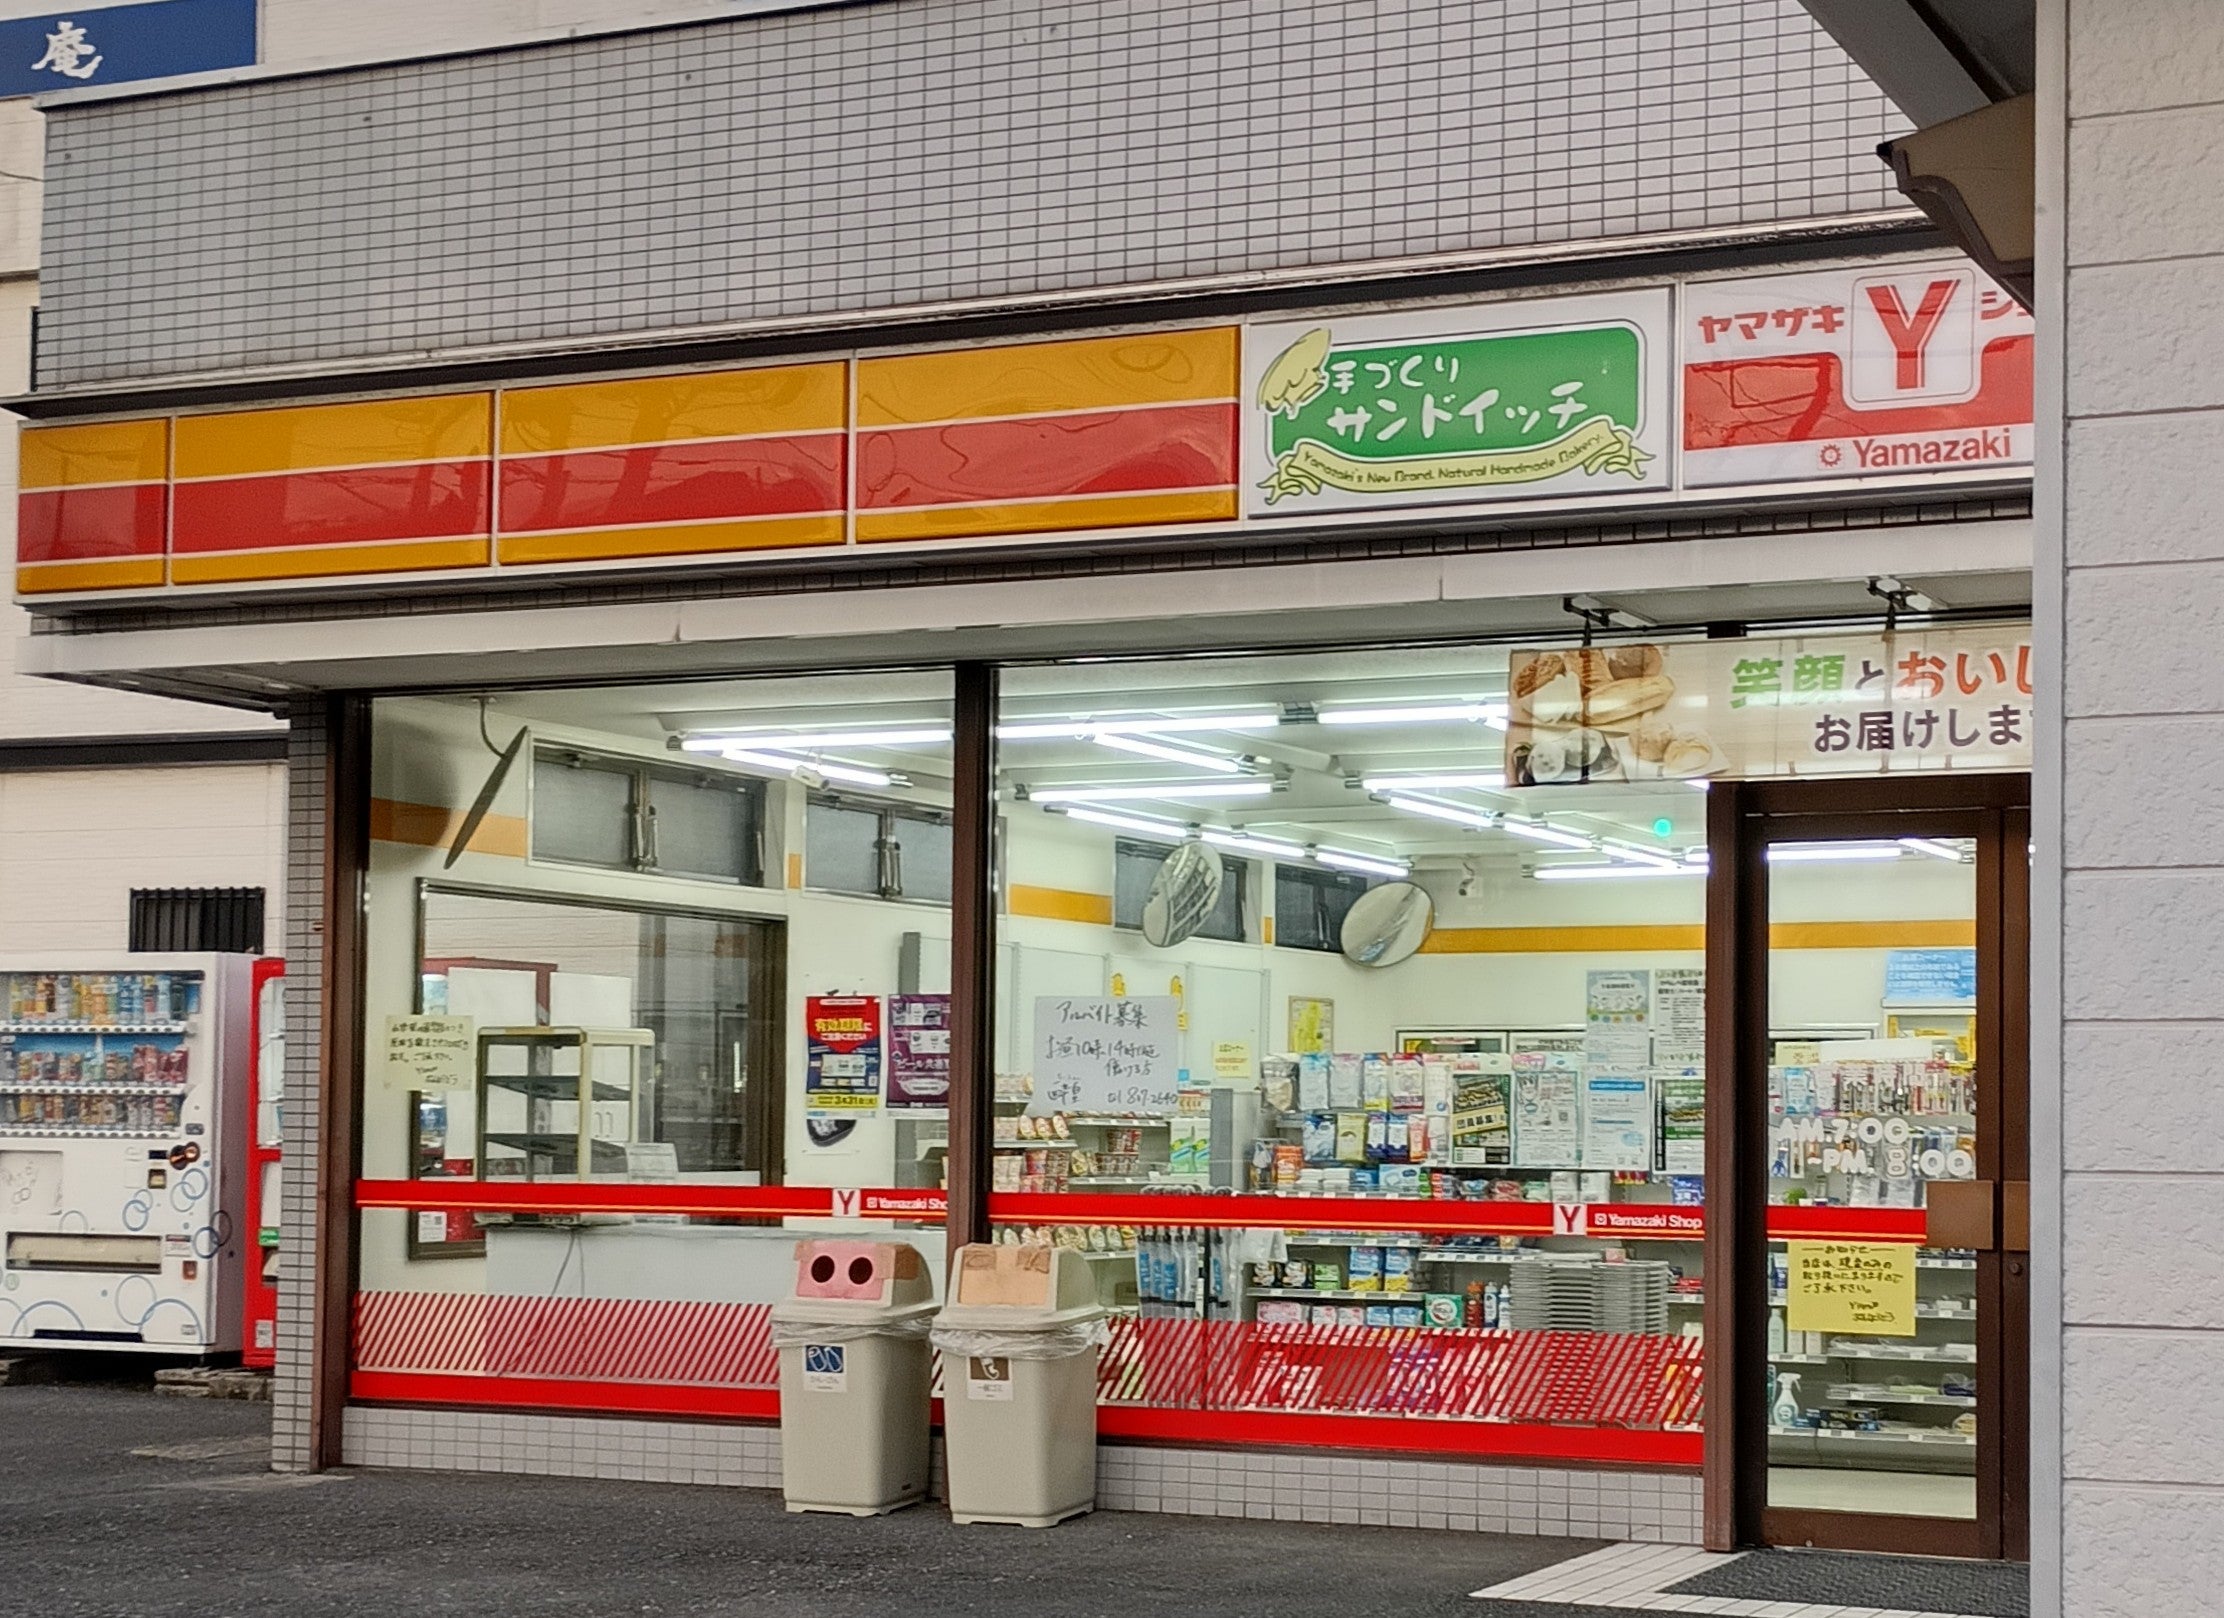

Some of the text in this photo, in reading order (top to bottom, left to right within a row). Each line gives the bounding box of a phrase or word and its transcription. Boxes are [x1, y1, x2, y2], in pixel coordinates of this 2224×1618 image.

[31, 21, 103, 79] 庵
[1697, 304, 1845, 344] ヤマザキ
[1866, 278, 1962, 390] Y
[1330, 354, 1459, 394] 手づくり
[1326, 379, 1589, 443] サンドイッチ
[1303, 450, 1364, 485] Yamazaki's
[1366, 471, 1391, 483] New
[1438, 463, 1487, 478] Natural
[1489, 457, 1556, 475] Handmade
[1852, 427, 2012, 468] Yamazaki
[837, 1190, 855, 1215] Y
[1559, 1205, 1581, 1232] Y
[1608, 1213, 1703, 1229] Yamazaki Shop
